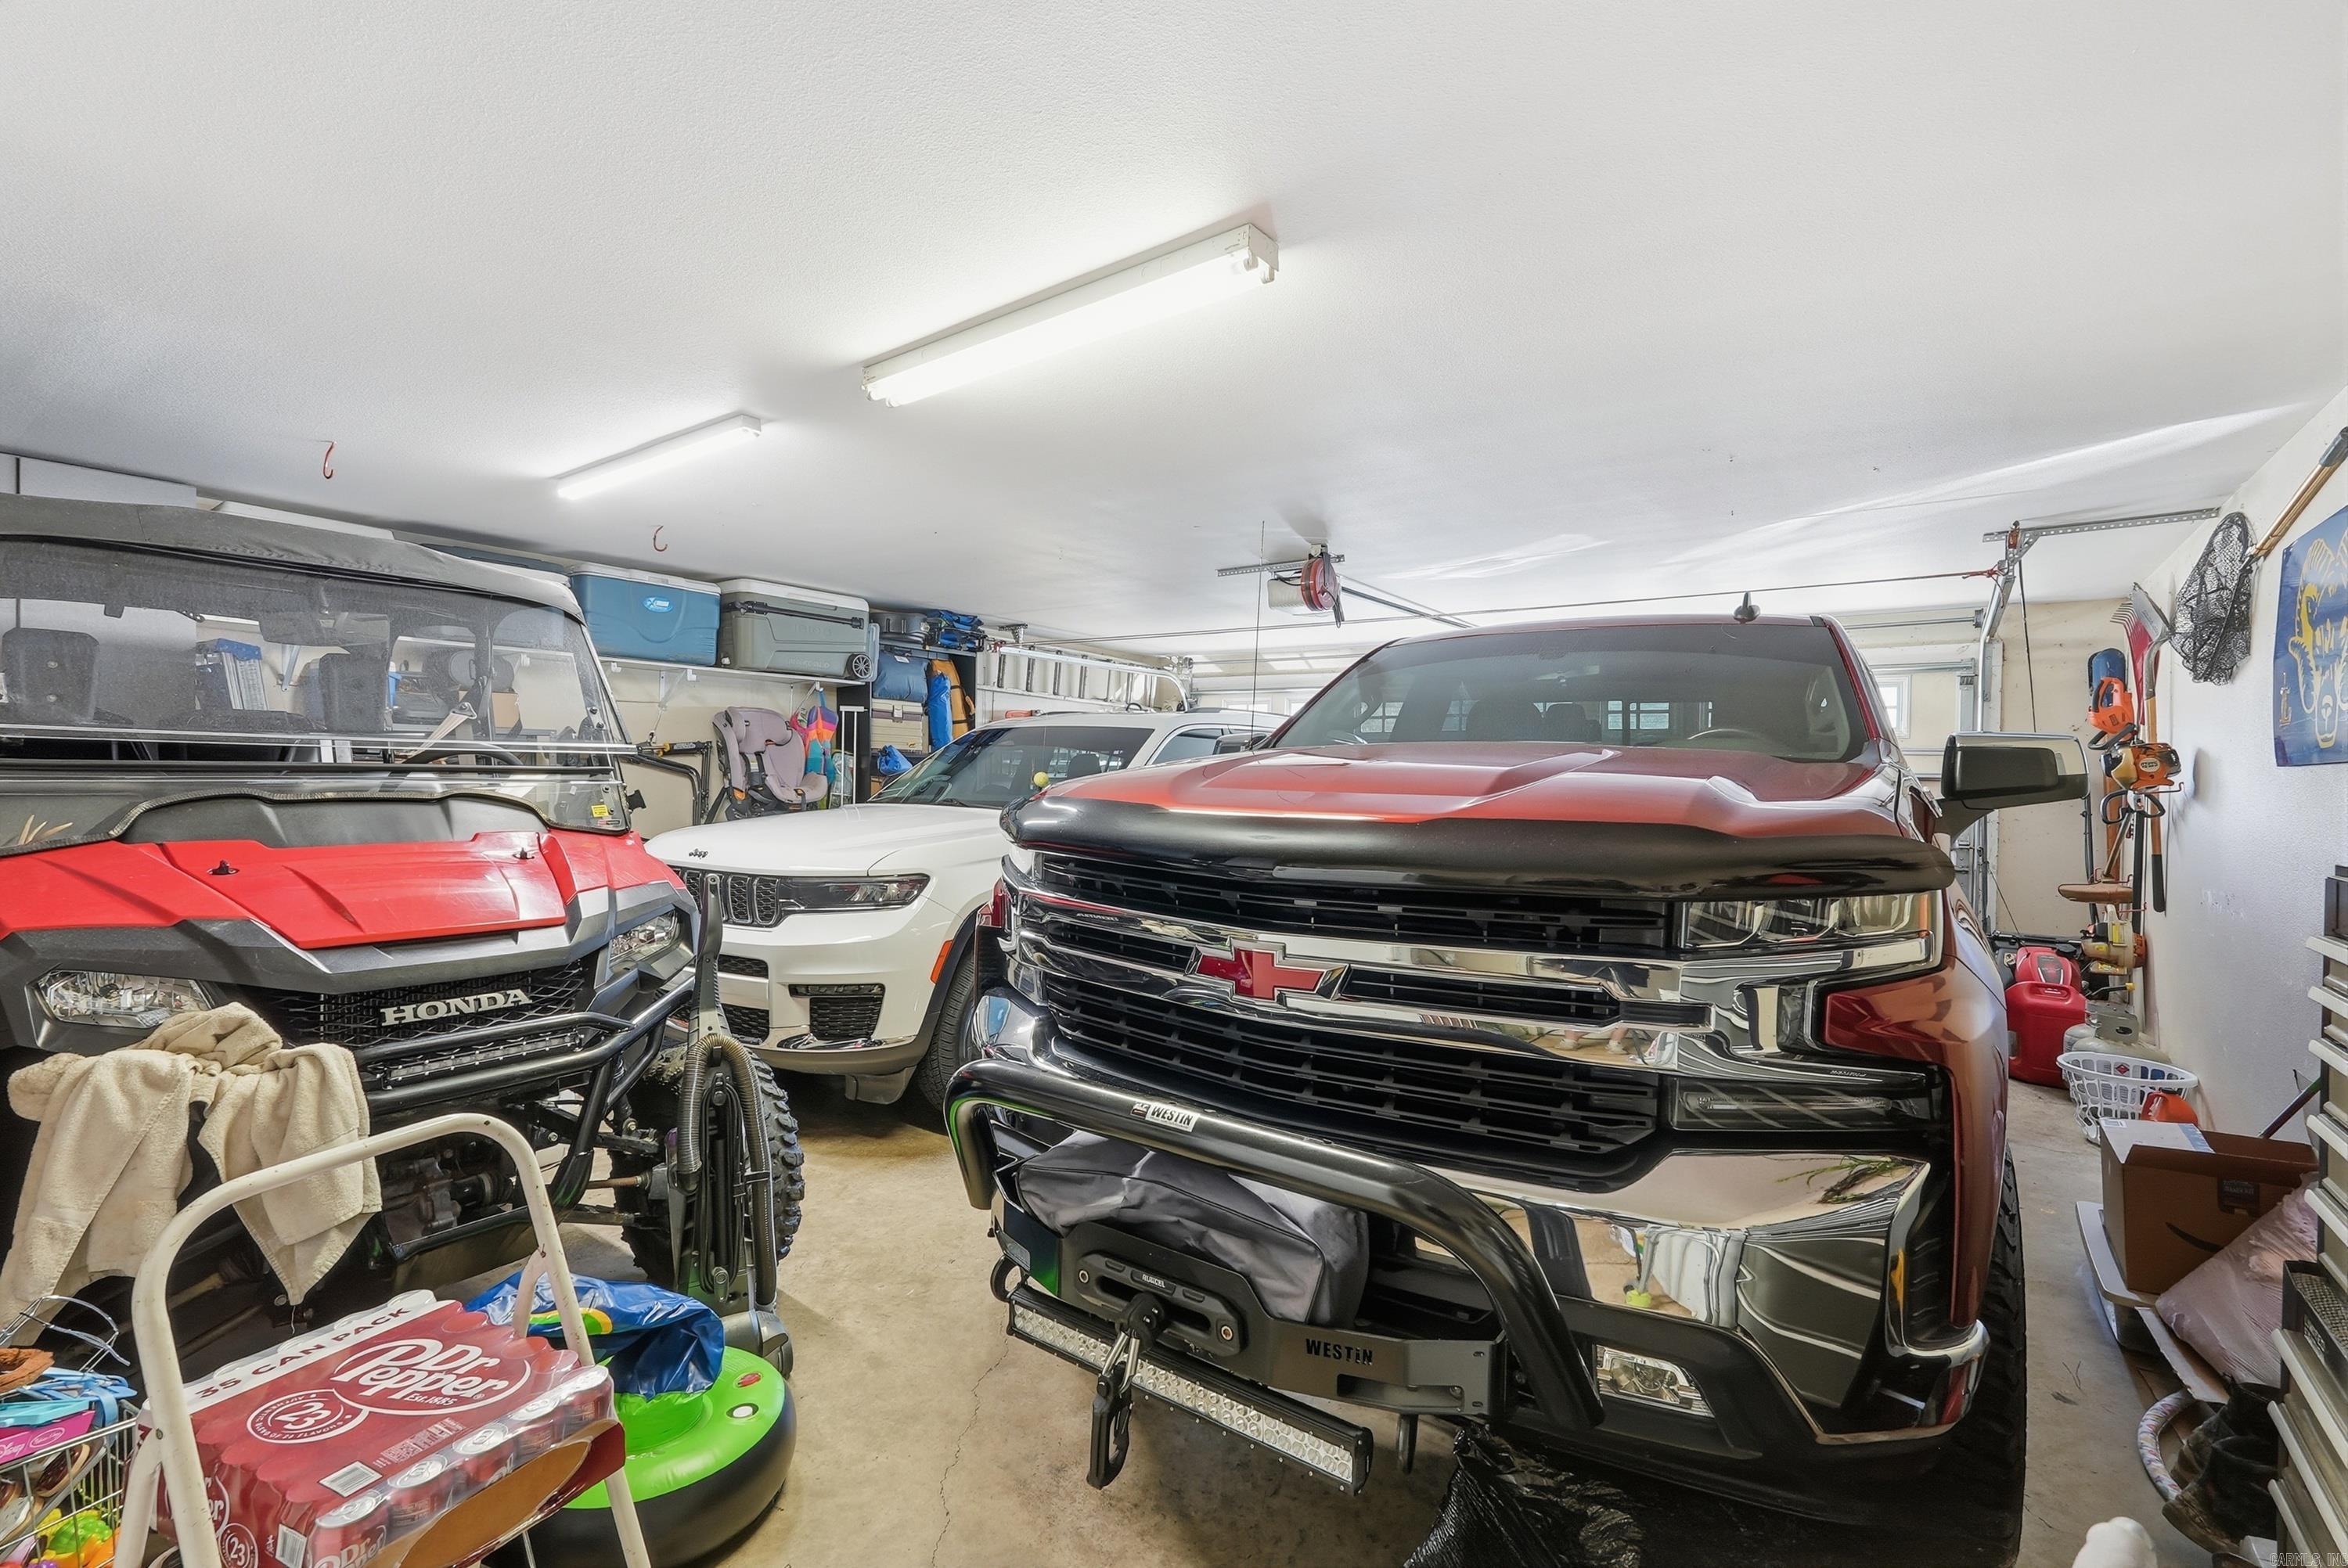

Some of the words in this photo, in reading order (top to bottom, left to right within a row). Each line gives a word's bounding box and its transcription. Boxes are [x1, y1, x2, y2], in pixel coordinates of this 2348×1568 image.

[380, 988, 533, 1027] HONDA
[1151, 1106, 1194, 1126] WESTIN
[195, 1378, 242, 1399] 35
[251, 1343, 326, 1376] CAN
[331, 1307, 411, 1342] PACK
[412, 1343, 501, 1375] Dr
[330, 1338, 510, 1401] Pepper
[274, 1401, 332, 1430] 23
[229, 1537, 246, 1566] 23
